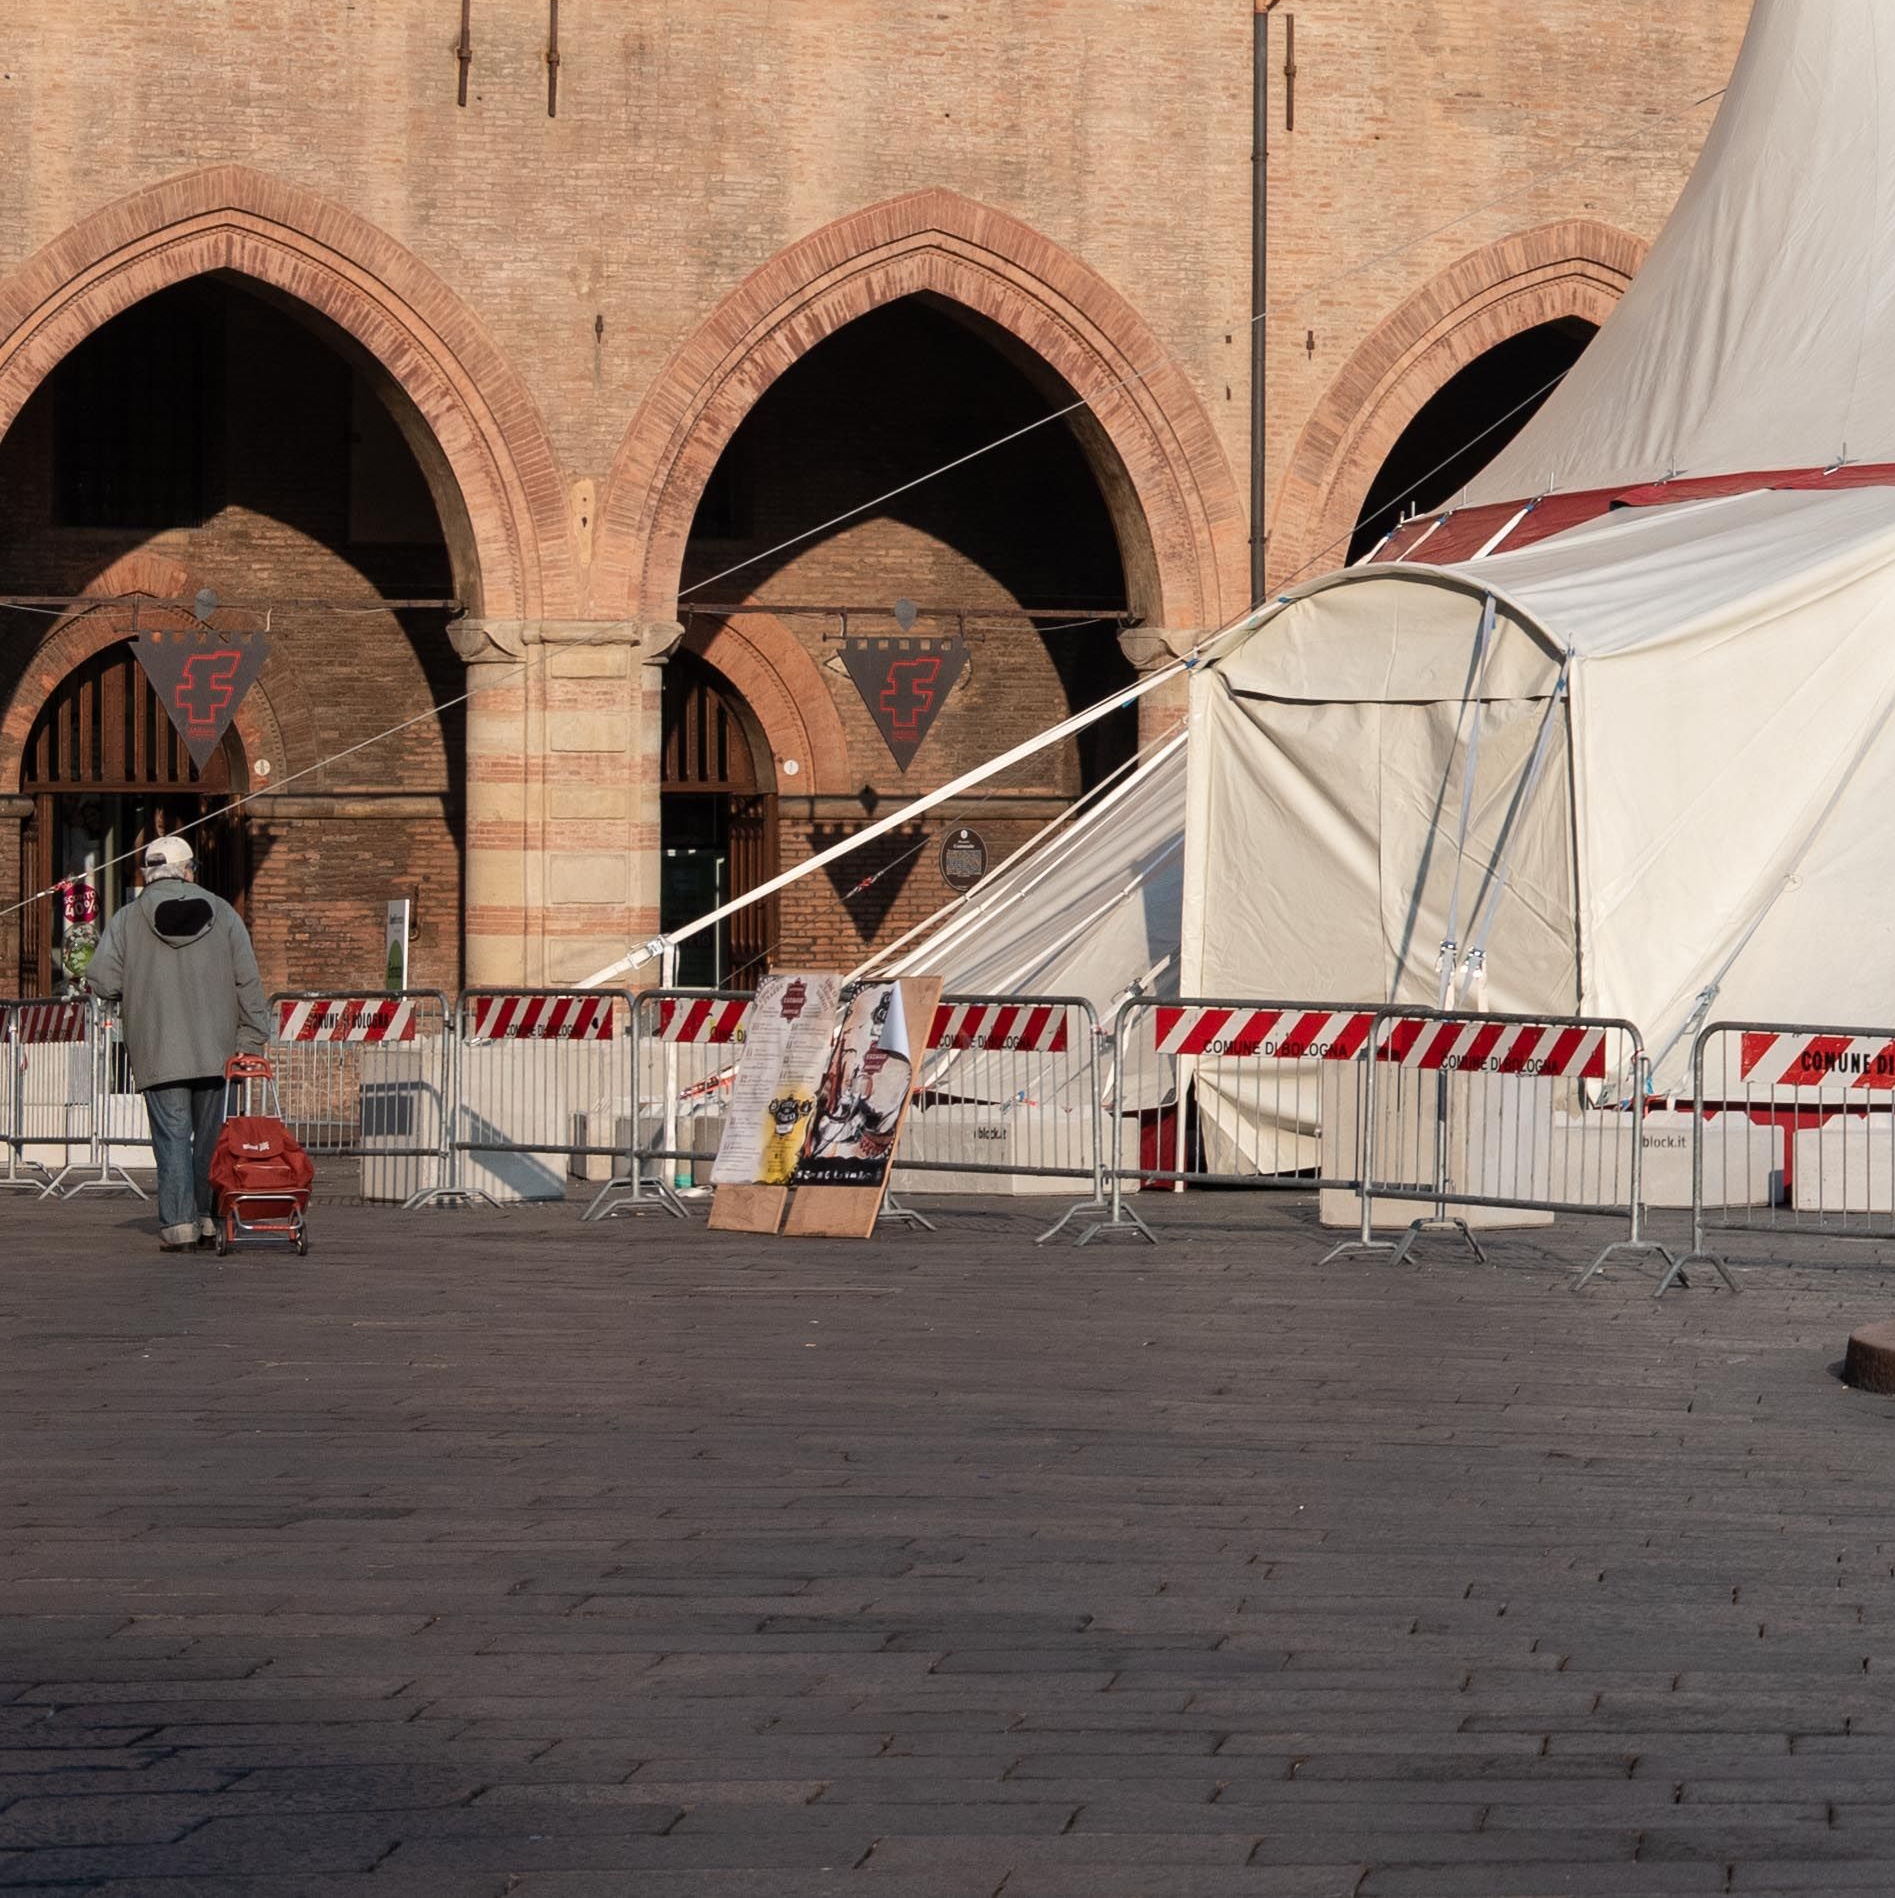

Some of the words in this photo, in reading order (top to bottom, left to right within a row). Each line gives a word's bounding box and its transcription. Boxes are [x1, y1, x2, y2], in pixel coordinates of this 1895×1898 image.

[65, 898, 100, 918] 40%
[1203, 1039, 1260, 1055] COMUNE
[1264, 1041, 1278, 1056] DI
[1281, 1041, 1350, 1059] BOLOGNA
[1440, 1053, 1489, 1071] COMUNE
[1490, 1055, 1502, 1072] DI
[1504, 1056, 1560, 1074] BOLOGNA
[1800, 1050, 1871, 1075] COMUNE
[1876, 1053, 1894, 1076] DI
[1641, 1135, 1687, 1149] block.it
